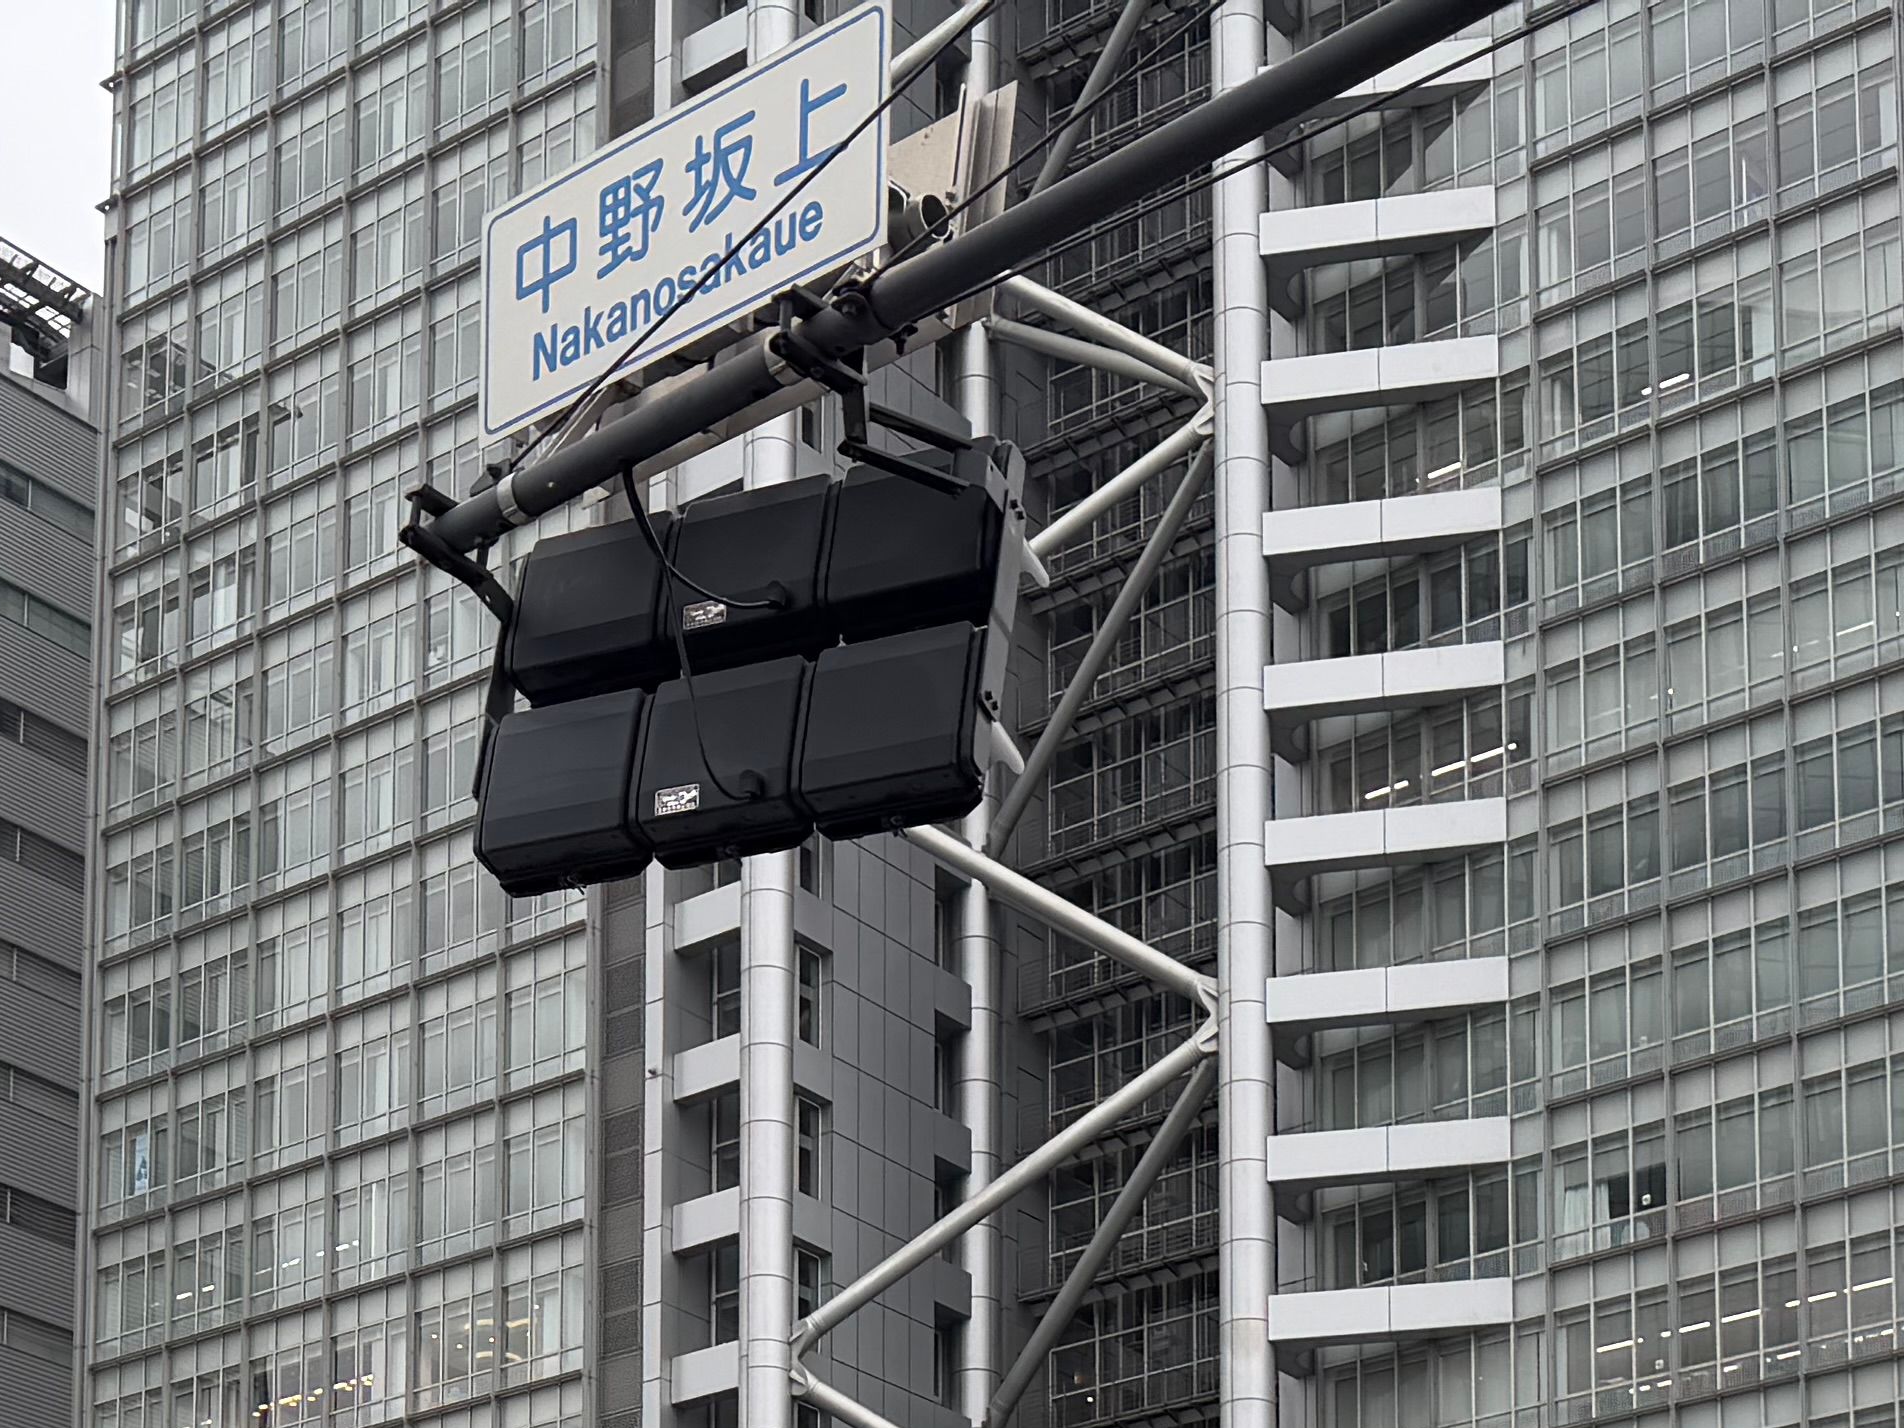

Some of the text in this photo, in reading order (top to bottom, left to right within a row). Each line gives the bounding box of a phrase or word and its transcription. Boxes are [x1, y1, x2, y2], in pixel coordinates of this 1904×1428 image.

[515, 78, 847, 314] 中野坂上
[532, 200, 824, 381] Nakanosakaue
